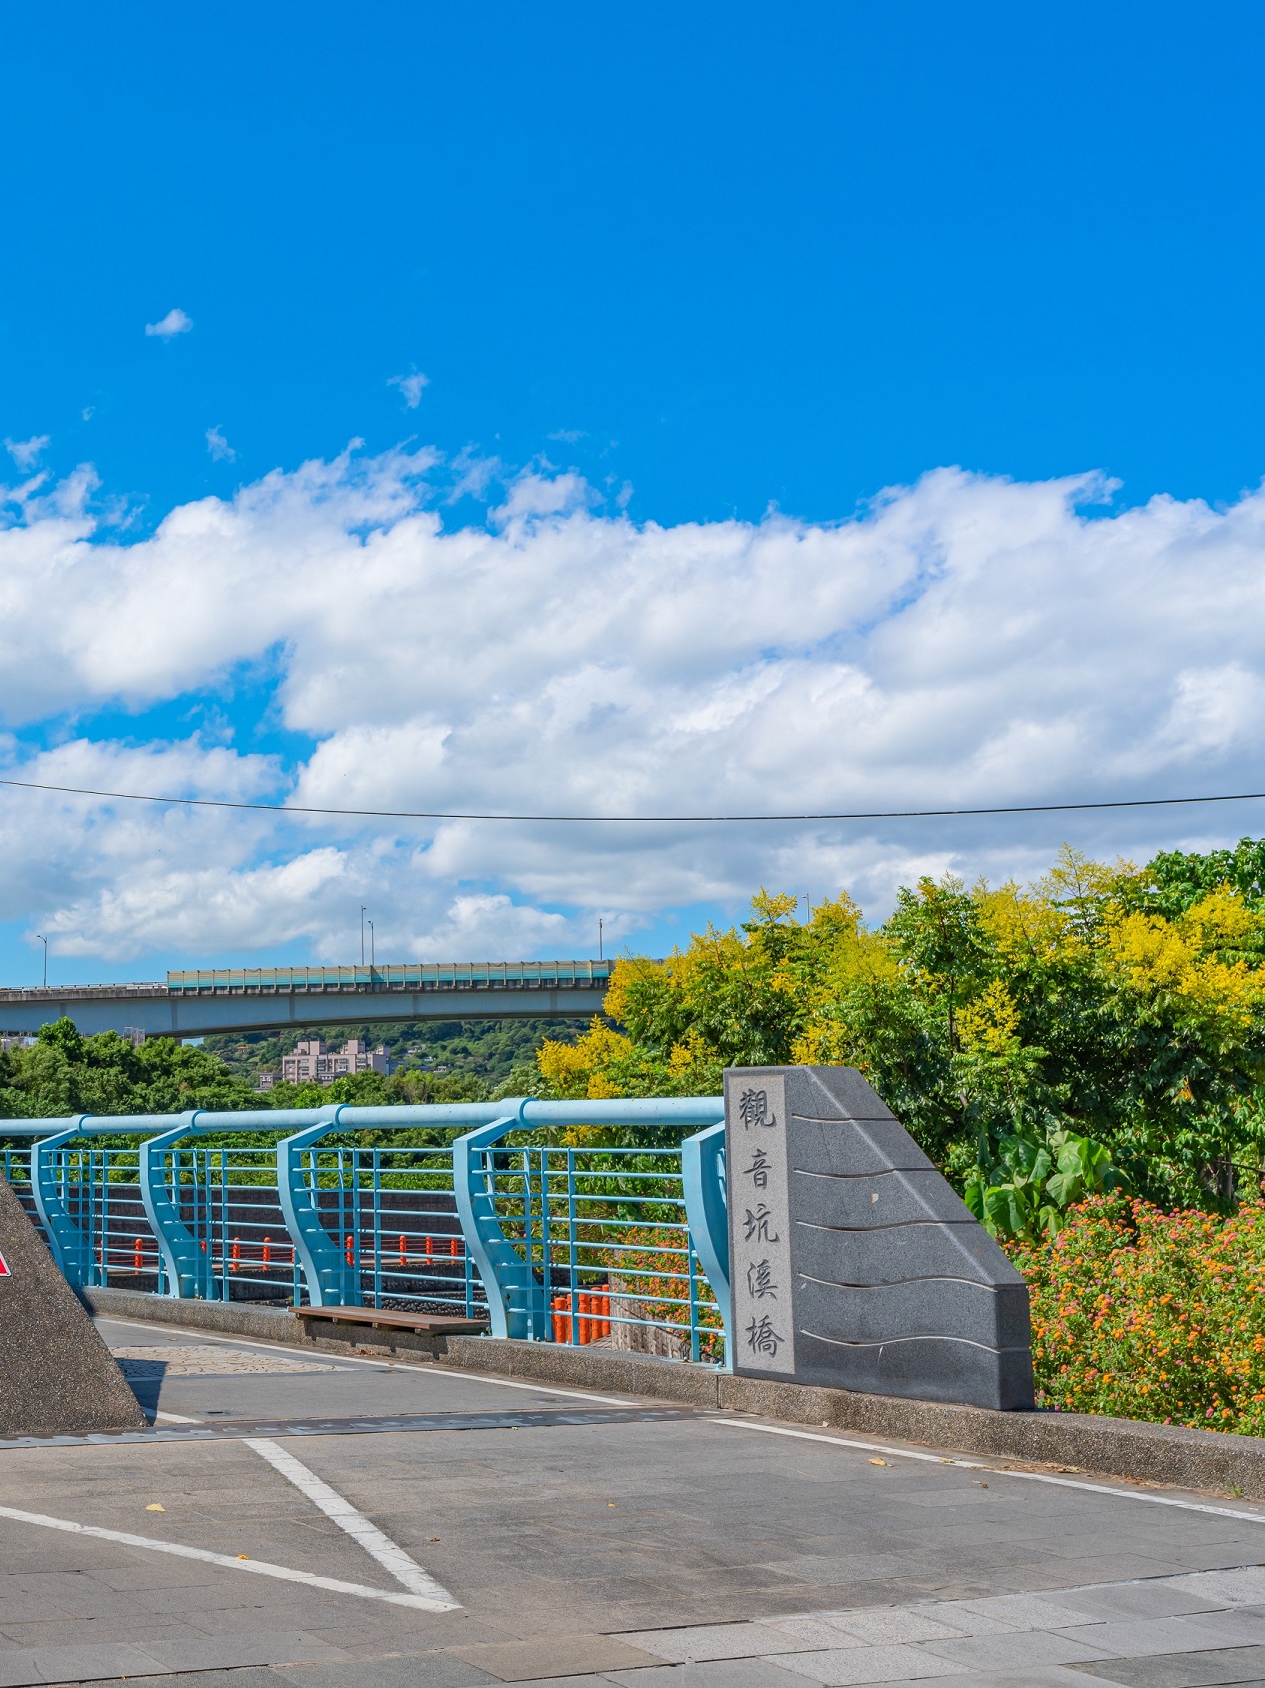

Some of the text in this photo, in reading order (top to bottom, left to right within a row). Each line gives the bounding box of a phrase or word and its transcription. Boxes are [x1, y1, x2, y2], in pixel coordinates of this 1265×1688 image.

[738, 1089, 785, 1358] 觀音坑溪橋
